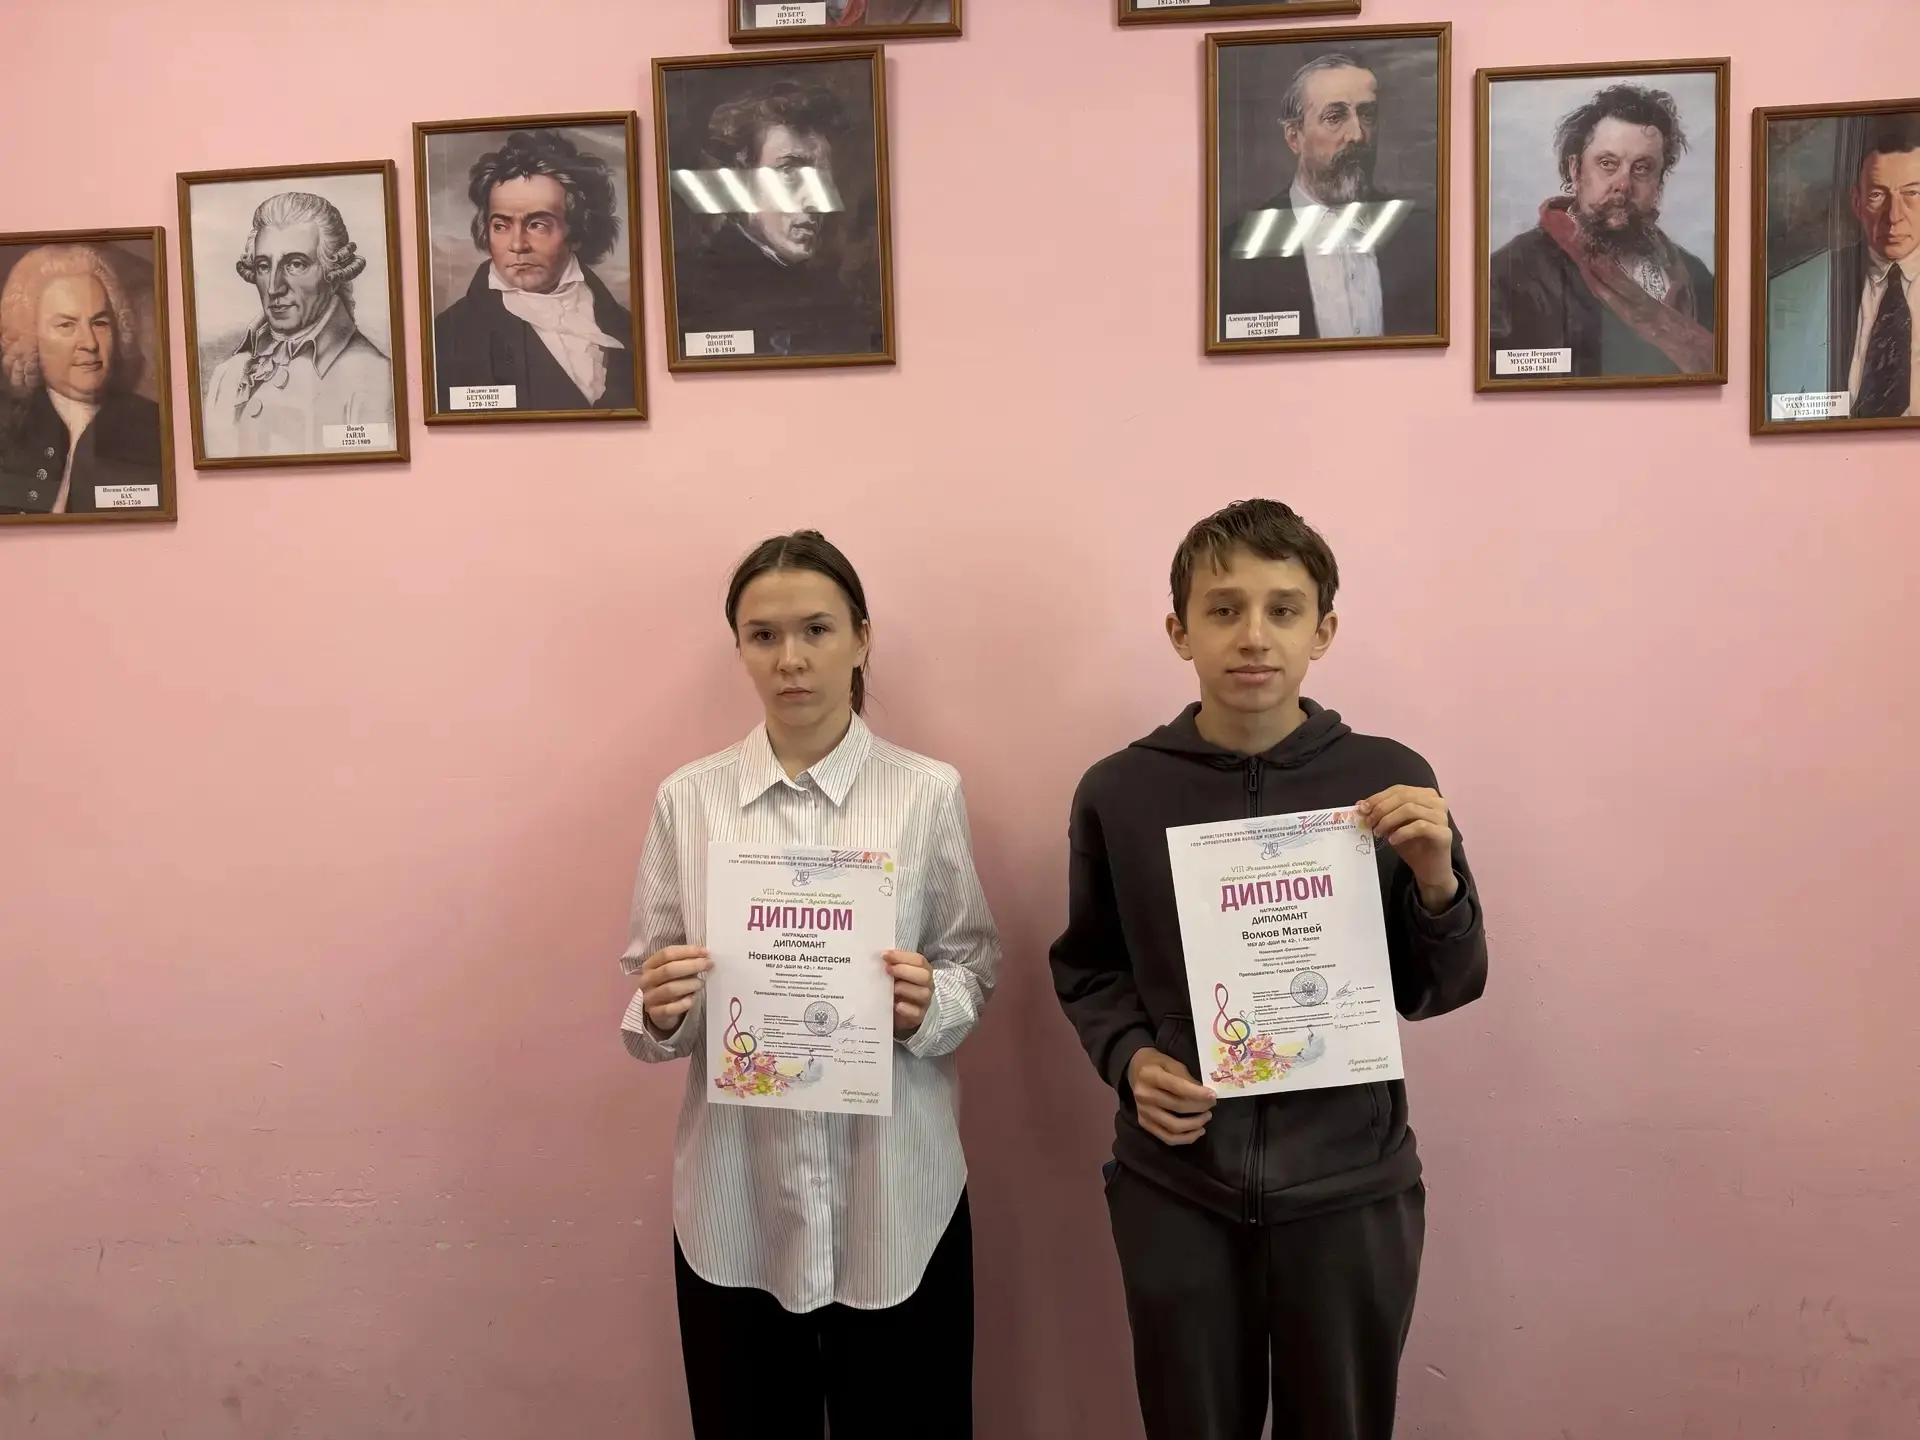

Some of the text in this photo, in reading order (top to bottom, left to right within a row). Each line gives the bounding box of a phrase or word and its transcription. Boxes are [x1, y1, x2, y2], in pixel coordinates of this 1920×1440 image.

[1221, 874, 1333, 912] ДИПЛОМ
[1260, 905, 1298, 913] НАГРАЖДАЕТСЯ
[748, 906, 852, 931] ДИПЛОМ
[1252, 912, 1308, 926] ДИПЛОМАНТ
[1242, 923, 1322, 940] Волков Матвей
[773, 940, 826, 948] ДИПЛОМАНТ
[748, 952, 851, 964] Новикова Анастасия
